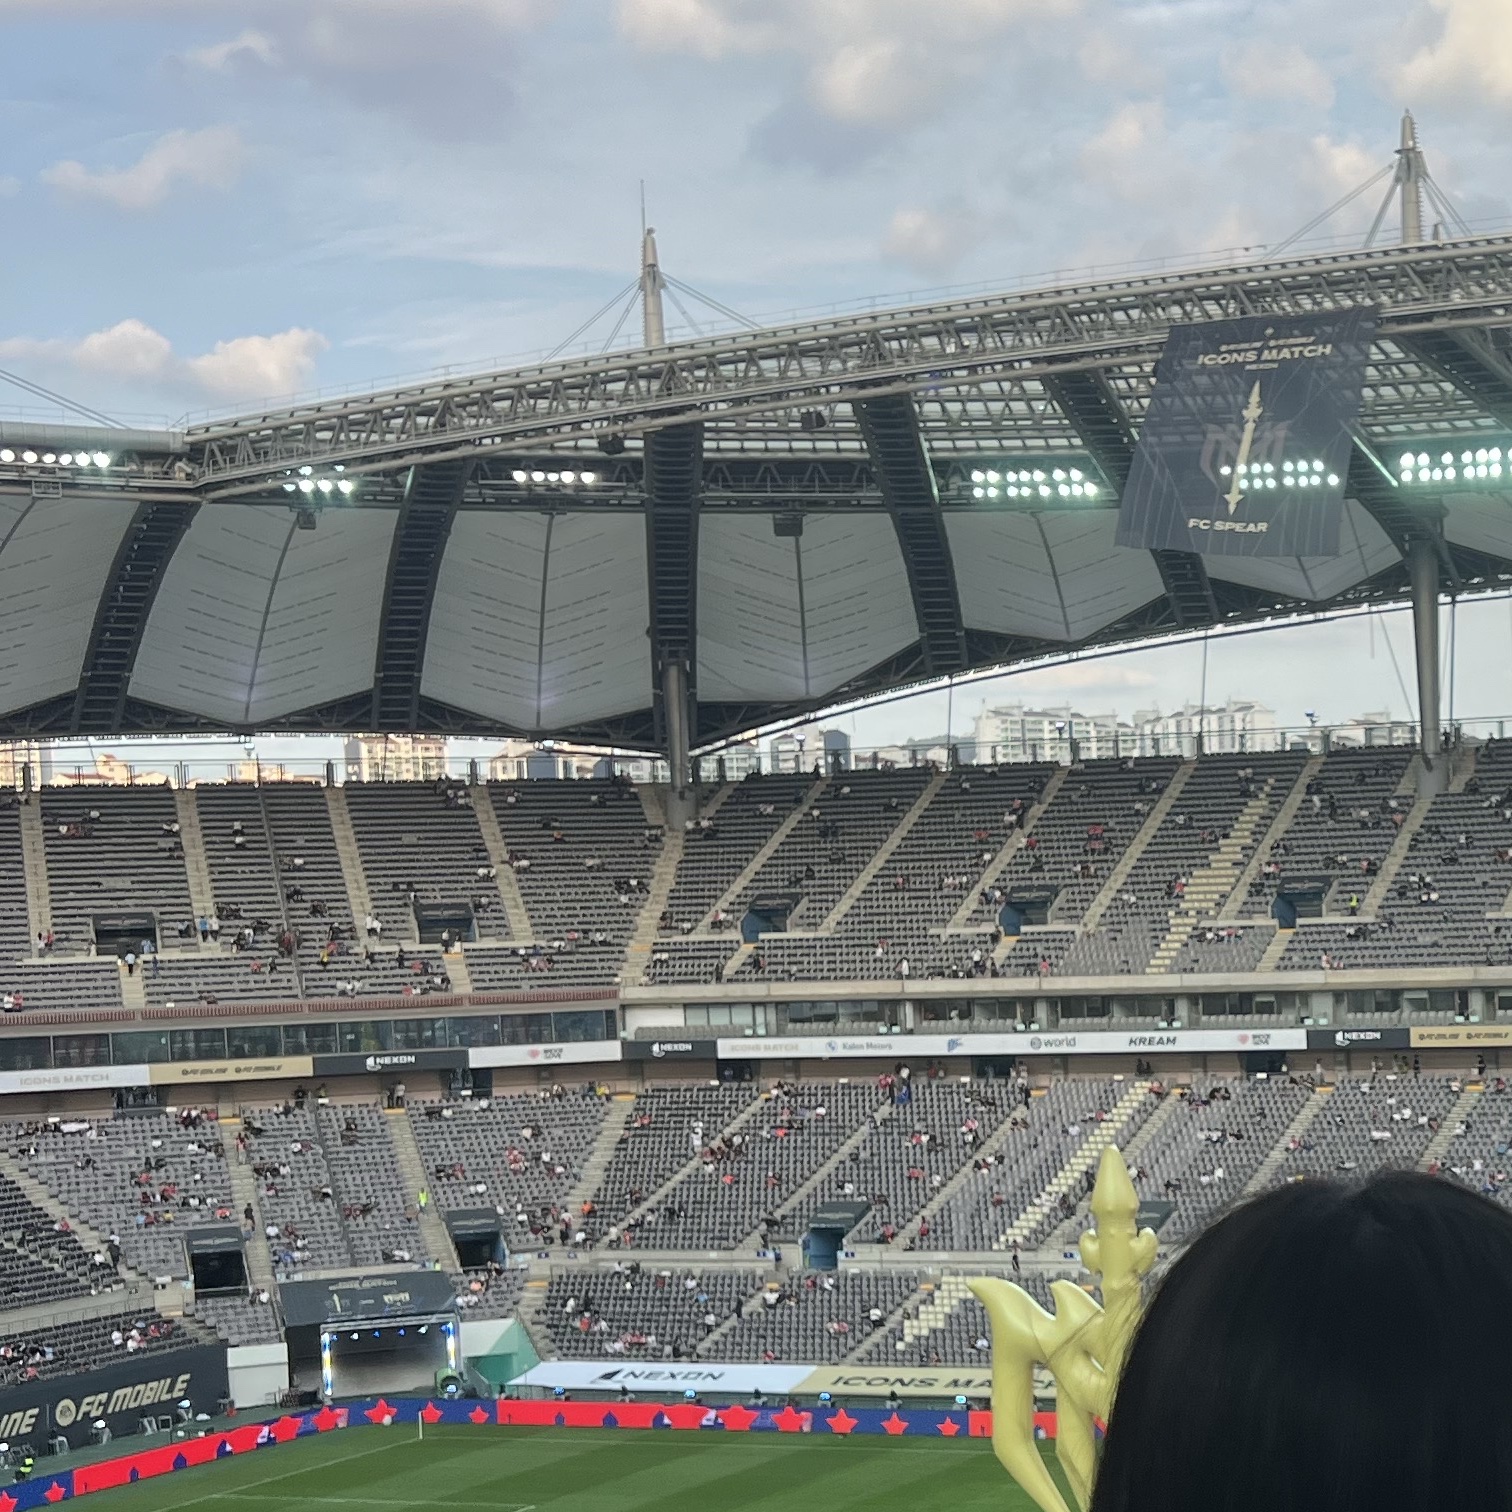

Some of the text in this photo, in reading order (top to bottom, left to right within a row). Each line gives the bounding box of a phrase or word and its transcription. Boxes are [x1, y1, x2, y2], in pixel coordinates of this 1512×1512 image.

[1196, 350, 1259, 365] ICONS
[1260, 343, 1333, 361] MATCH
[1187, 518, 1269, 533] FC SPEAR
[1043, 1035, 1077, 1048] world
[1128, 1035, 1177, 1047] KREAM
[376, 1055, 416, 1065] NEXON
[20, 1073, 109, 1086] ICONS MATCH
[620, 1369, 725, 1382] NEXON
[831, 1376, 939, 1389] ICONS
[75, 1373, 191, 1422] FC MOBILE
[0, 1407, 39, 1439] INE
